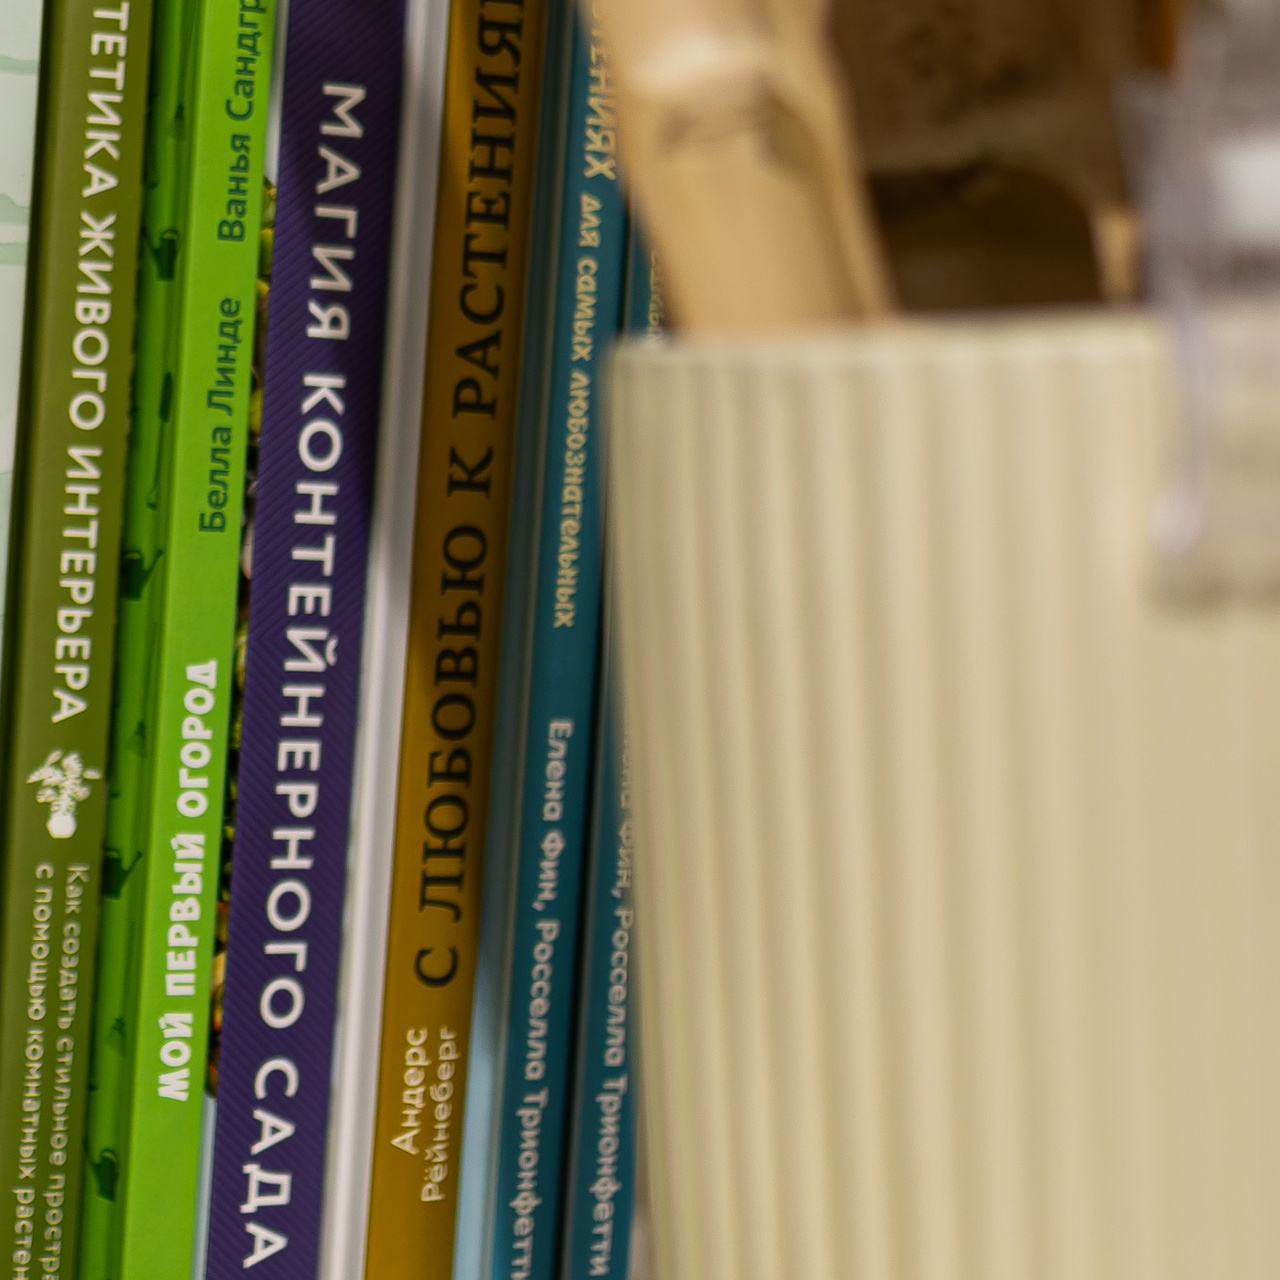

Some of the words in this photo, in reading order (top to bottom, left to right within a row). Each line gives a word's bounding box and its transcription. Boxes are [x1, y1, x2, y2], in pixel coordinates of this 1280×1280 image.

[217, 133, 252, 242] Ванья
[306, 82, 367, 341] МАГИЯ
[68, 210, 116, 431] ЖИВОГО
[207, 297, 243, 416] Линде
[199, 426, 233, 533] Белла
[447, 445, 496, 500] К
[52, 445, 103, 725] ИНТЕРЬЕРА
[176, 658, 218, 819] ОГОРОД
[260, 374, 346, 1030] КОНТЕЙНЕРНОГО
[420, 525, 488, 923] ЛЮБОВЬЮ
[542, 718, 574, 823] Елена
[34, 864, 54, 881] с
[64, 864, 90, 915] Как
[164, 832, 206, 996] ПЕРВЫЙ
[532, 829, 566, 912] Фин,
[27, 886, 53, 1021] помощью
[57, 921, 81, 1031] создать
[414, 946, 458, 988] С
[524, 920, 560, 1082] Росселла
[19, 1029, 45, 1180] комнатных
[49, 1036, 74, 1166] стильное
[157, 1011, 194, 1103] МОЙ
[390, 1026, 431, 1156] Андерс
[421, 1025, 461, 1203] Рёйнеберг
[240, 1057, 299, 1269] САДА
[588, 1073, 628, 1277] Трионфетти
